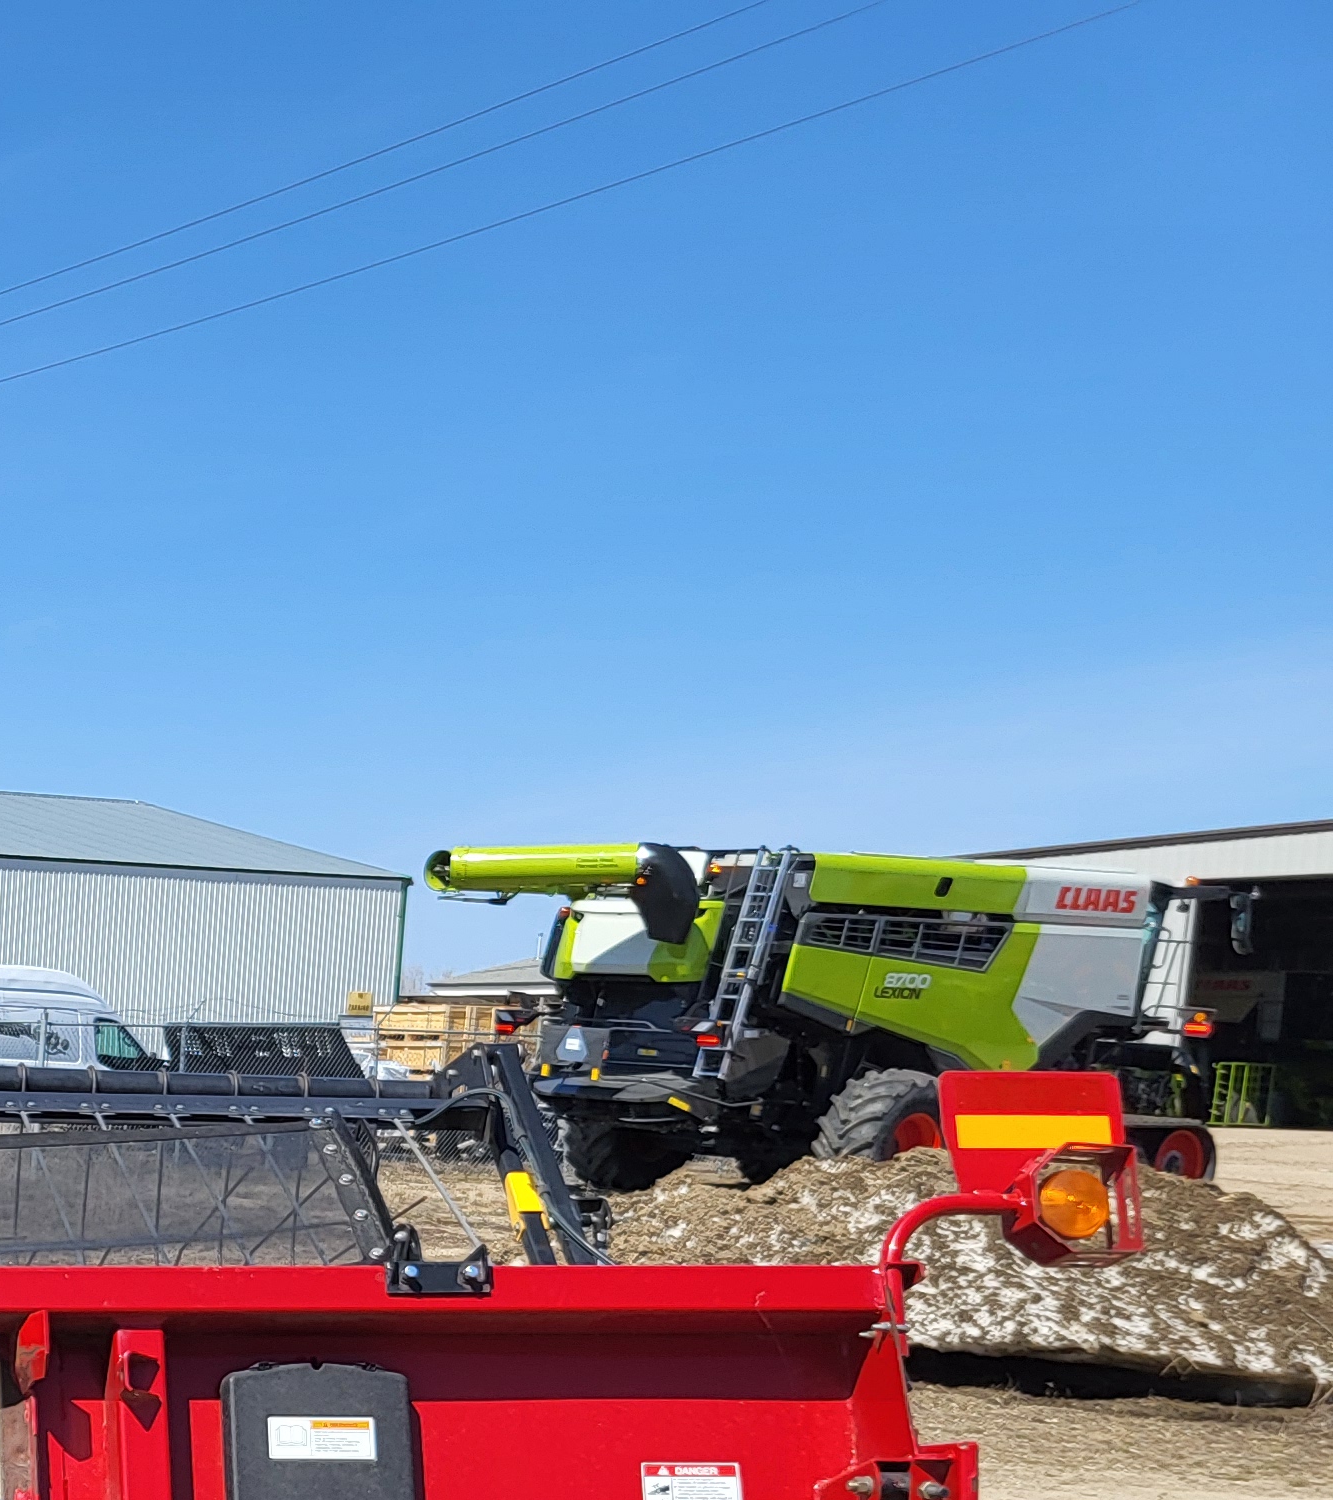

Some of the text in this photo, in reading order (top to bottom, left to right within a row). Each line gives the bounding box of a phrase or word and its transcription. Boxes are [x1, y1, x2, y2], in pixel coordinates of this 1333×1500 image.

[1055, 886, 1138, 913] CLAAS
[884, 972, 932, 989] 8700
[874, 986, 922, 999] LEXION
[674, 1466, 719, 1475] DANGER
